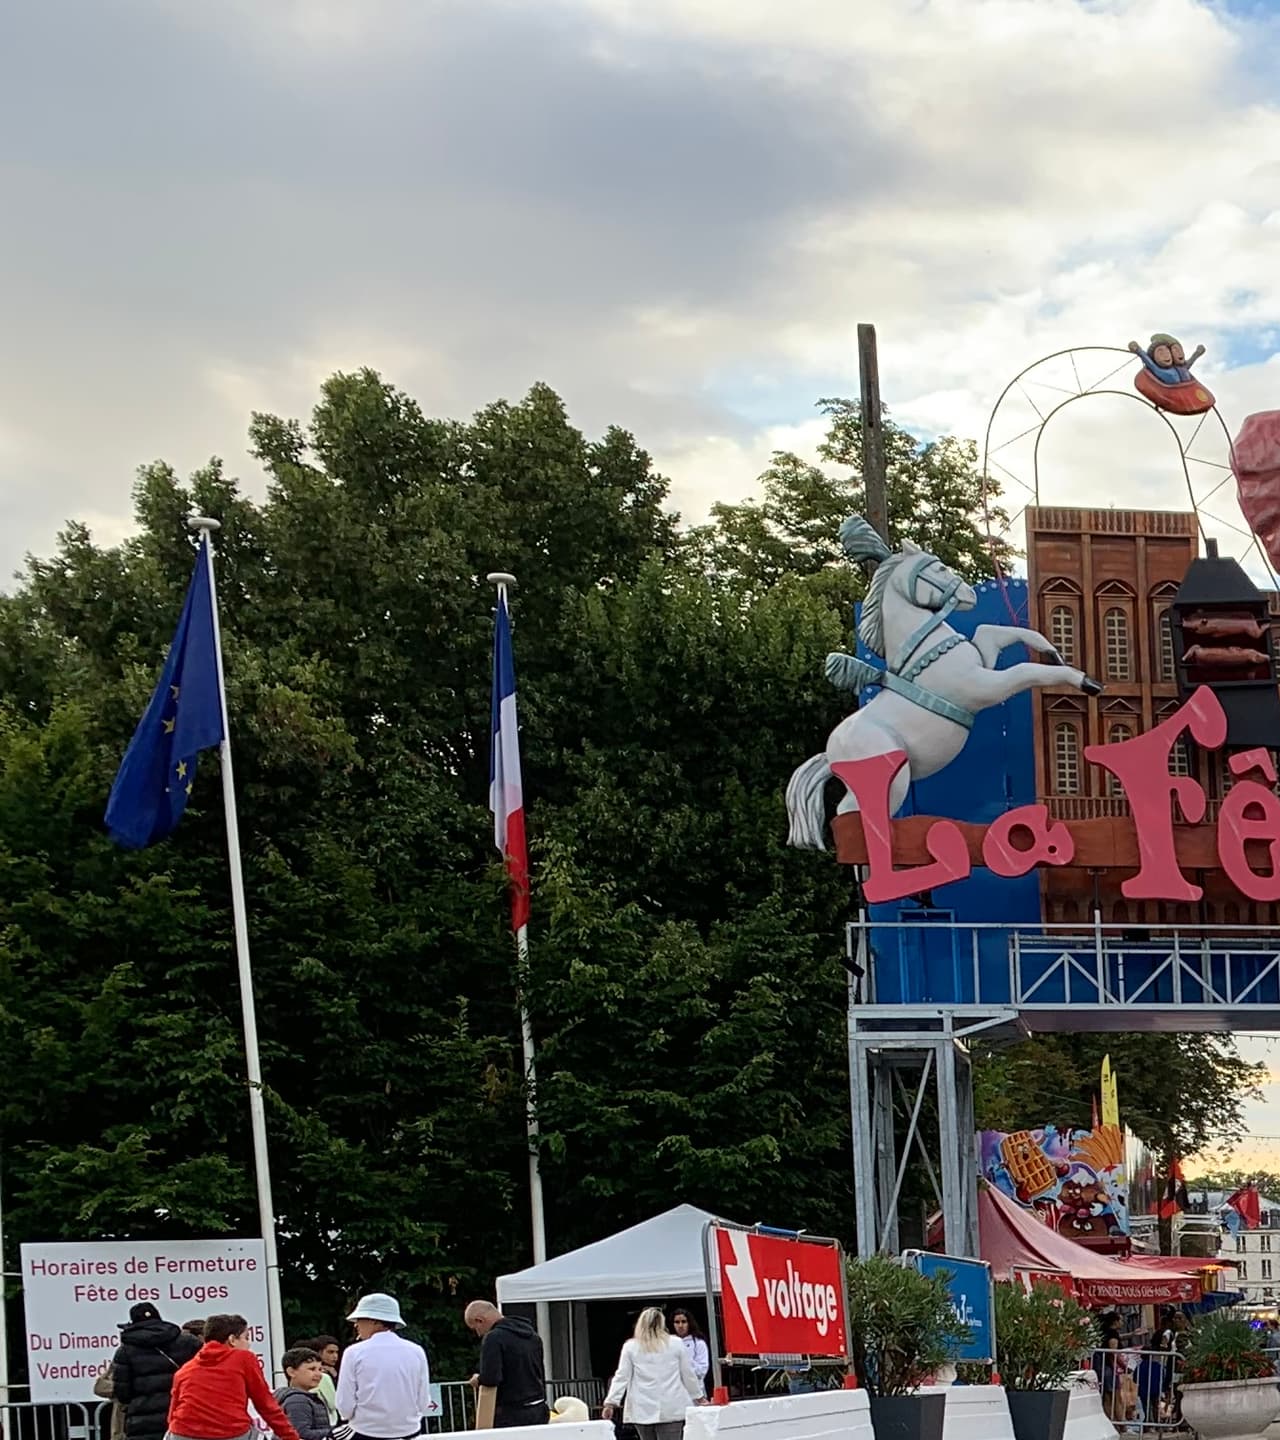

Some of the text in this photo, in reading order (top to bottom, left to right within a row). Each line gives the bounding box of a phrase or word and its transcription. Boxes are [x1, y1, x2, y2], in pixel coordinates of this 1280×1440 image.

[830, 750, 1074, 903] La
[31, 1256, 257, 1276] Horaires de Fermeture
[74, 1282, 228, 1303] Fête des Loges
[764, 1259, 837, 1336] voltage
[30, 1333, 52, 1351] Du
[59, 1332, 120, 1349] Dimanc
